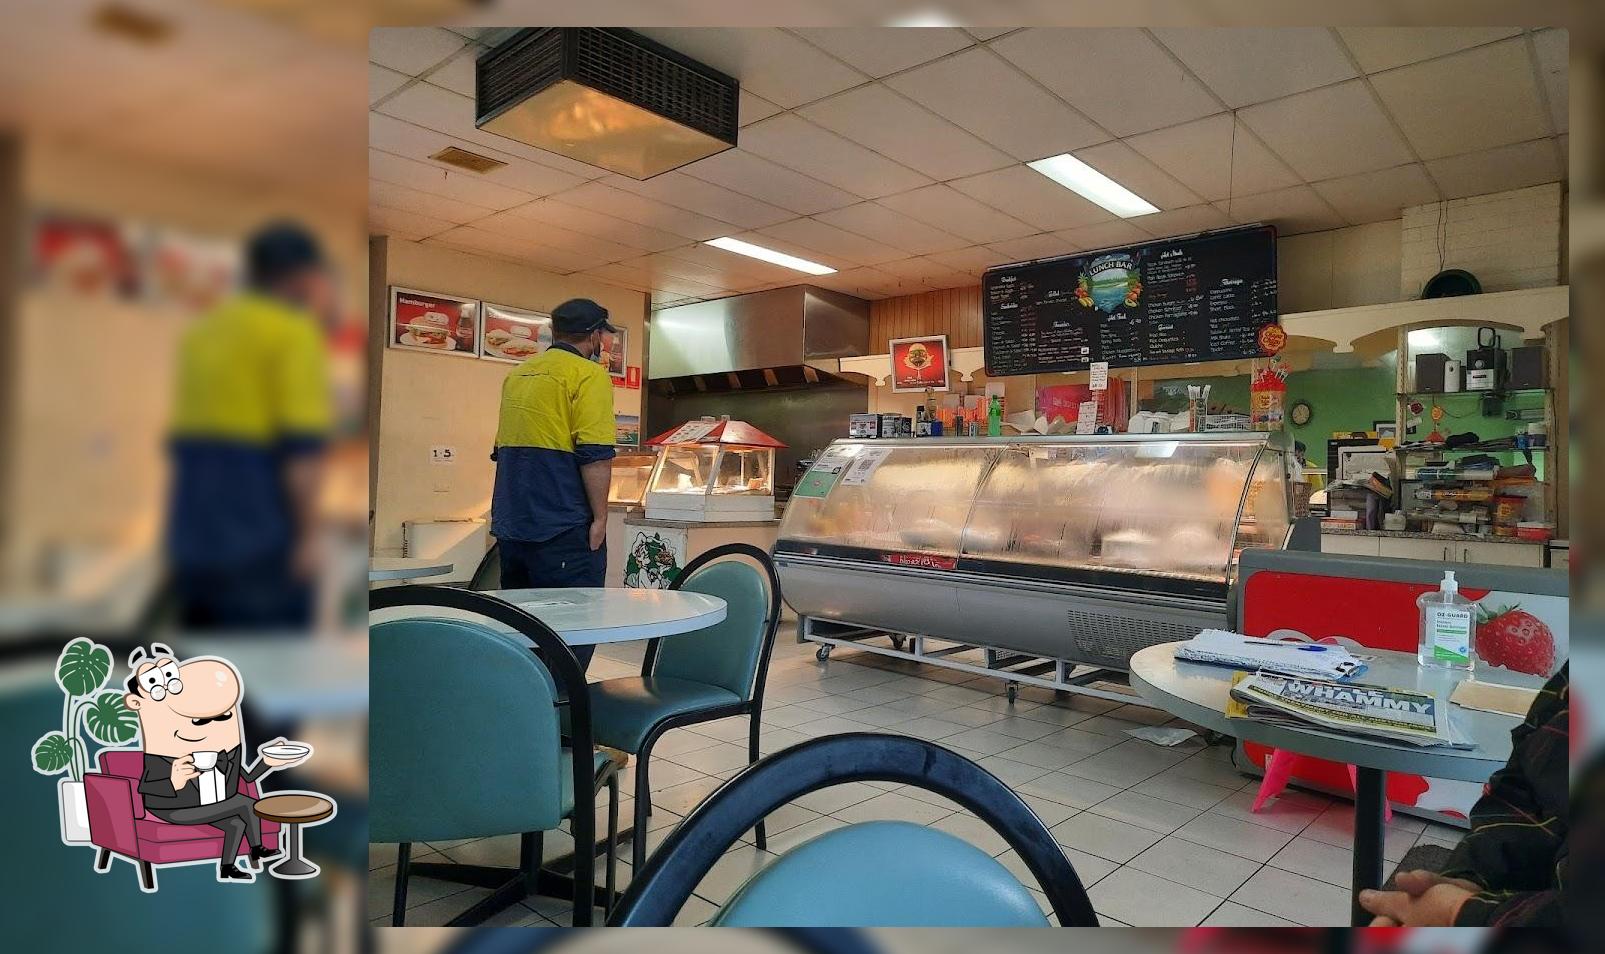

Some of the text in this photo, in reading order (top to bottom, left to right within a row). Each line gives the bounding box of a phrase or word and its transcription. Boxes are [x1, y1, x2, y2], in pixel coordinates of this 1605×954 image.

[1089, 262, 1114, 276] LUNCH
[1116, 261, 1133, 270] BAR
[1287, 680, 1431, 714] WHAMMY
